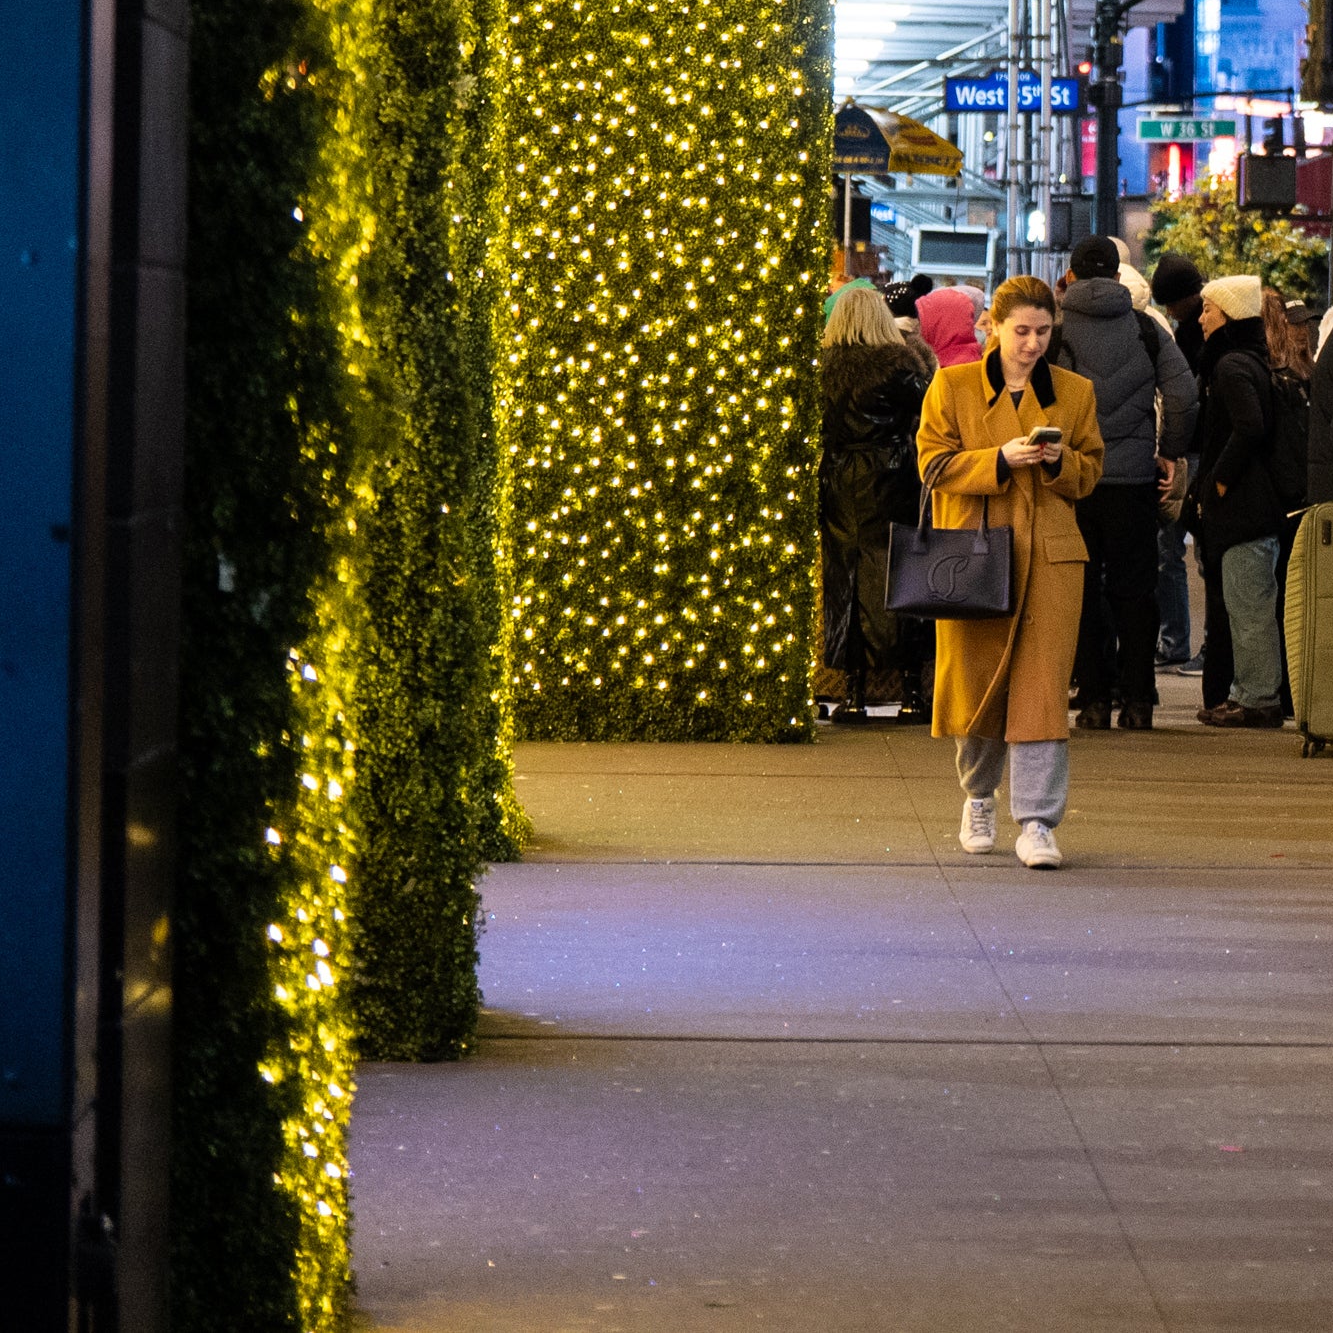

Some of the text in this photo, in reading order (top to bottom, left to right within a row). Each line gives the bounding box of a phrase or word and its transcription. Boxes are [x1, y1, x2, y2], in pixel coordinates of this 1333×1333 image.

[955, 85, 1005, 106] West
[1050, 85, 1070, 106] St
[1160, 121, 1215, 137] W 36 St
